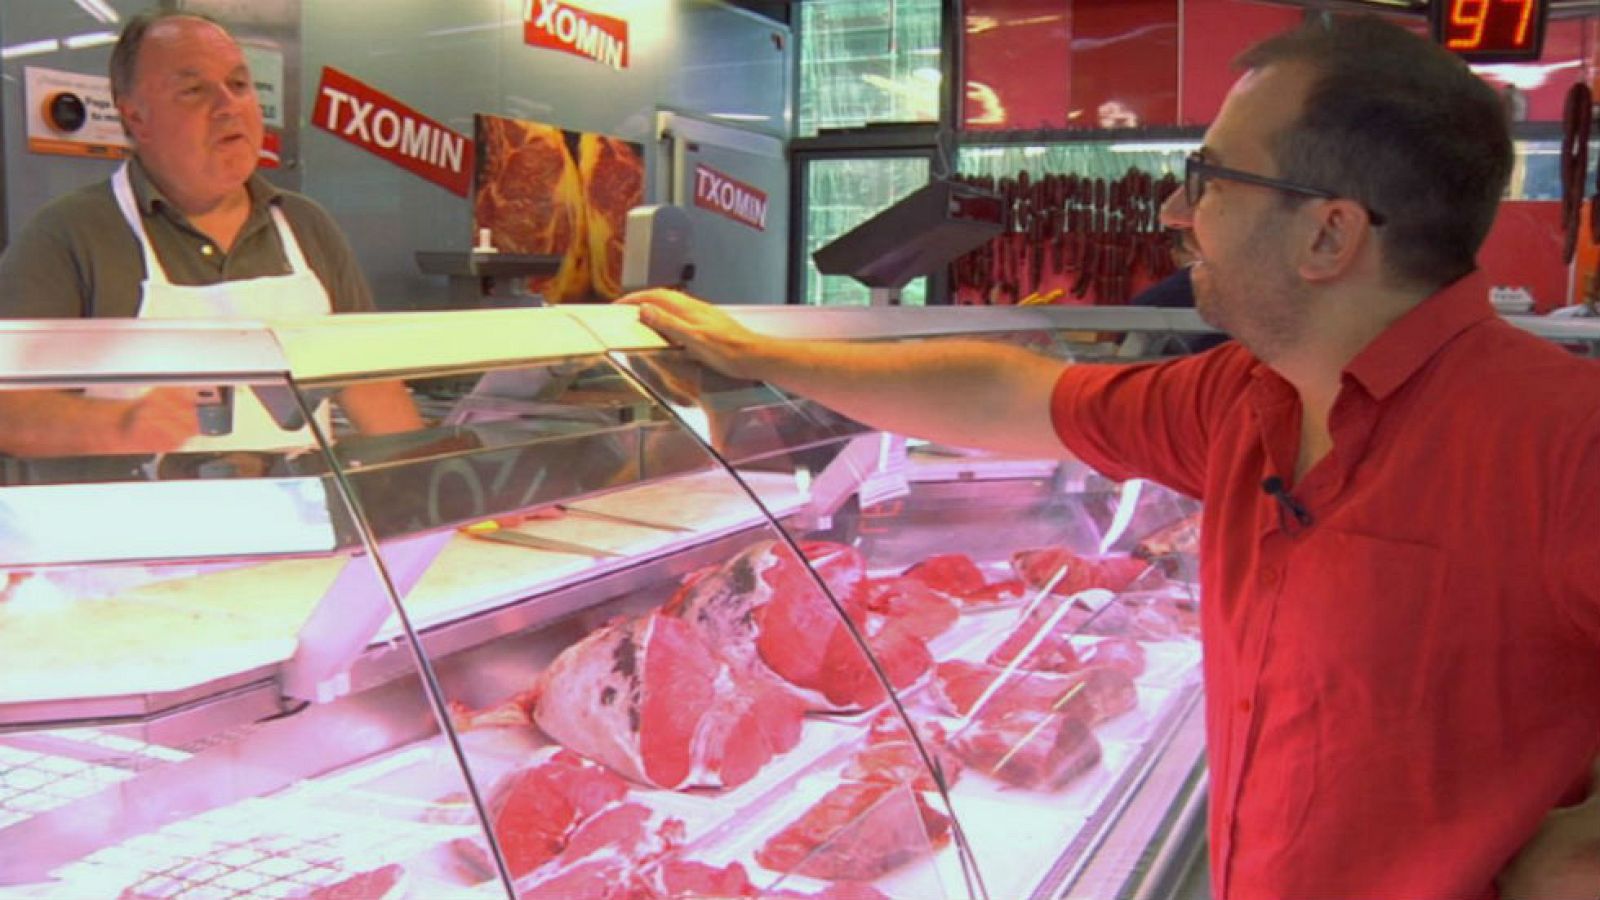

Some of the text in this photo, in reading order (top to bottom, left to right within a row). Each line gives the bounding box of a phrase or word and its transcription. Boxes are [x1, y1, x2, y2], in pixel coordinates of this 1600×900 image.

[1448, 0, 1533, 48] 97
[323, 86, 465, 173] TXOMIN
[696, 167, 767, 228] TXOMIN
